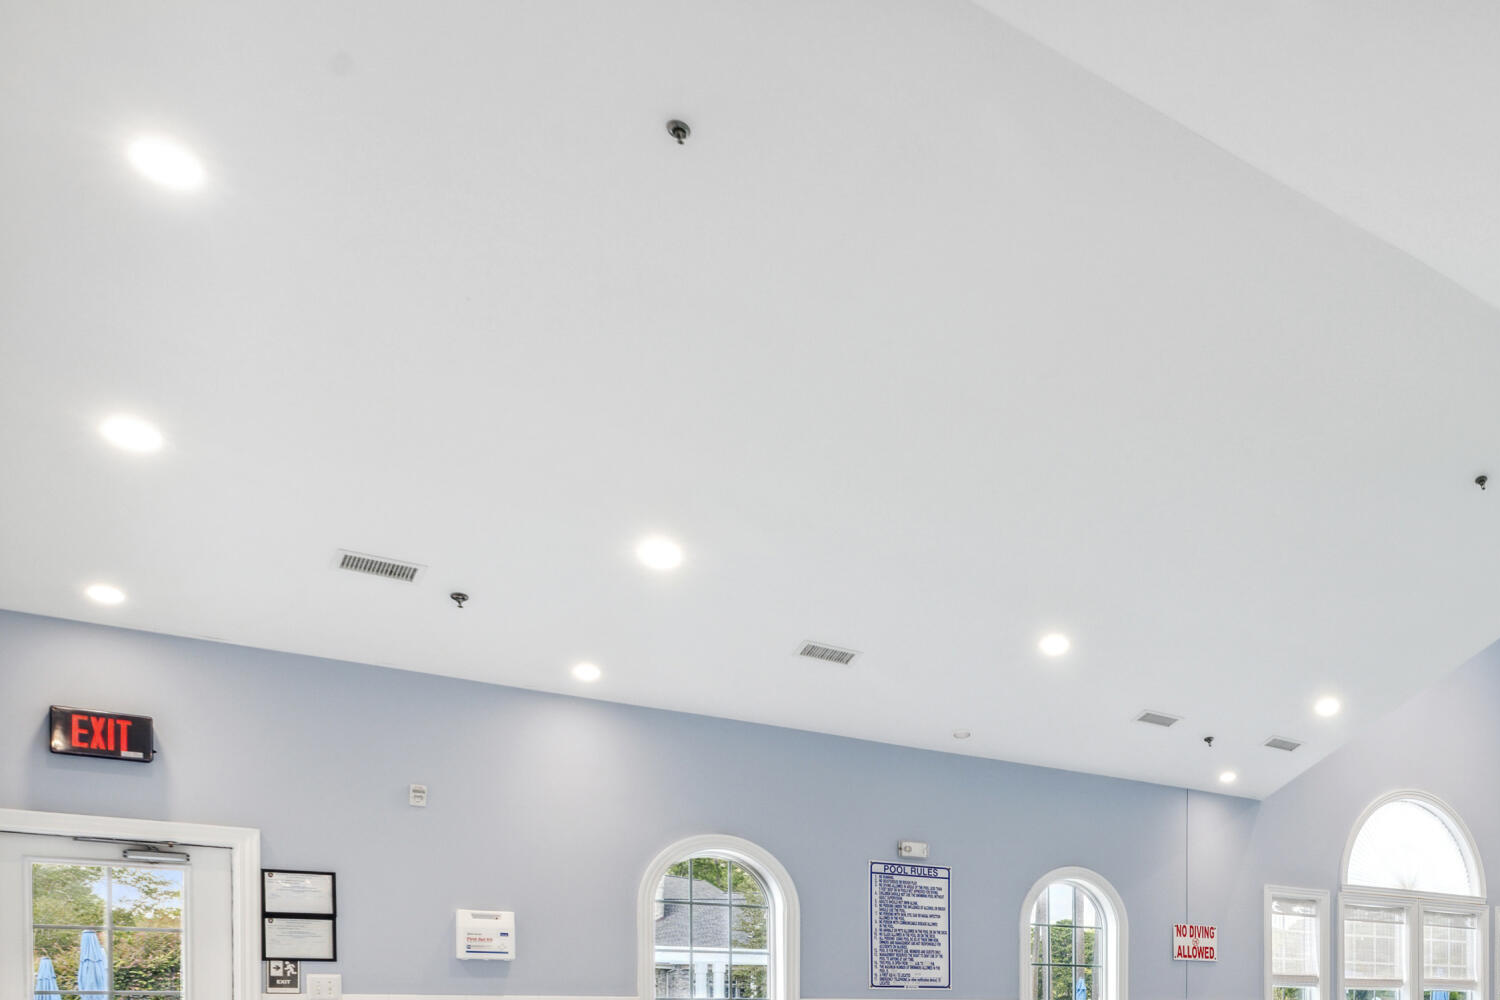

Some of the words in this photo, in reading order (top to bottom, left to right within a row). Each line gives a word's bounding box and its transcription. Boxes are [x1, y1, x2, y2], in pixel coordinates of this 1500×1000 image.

[72, 714, 132, 751] EXIT
[883, 865, 908, 874] POOL
[910, 867, 938, 877] RULES
[1176, 924, 1187, 937] NO
[1190, 925, 1215, 939] DIVING
[1177, 945, 1215, 959] ALLOWED
